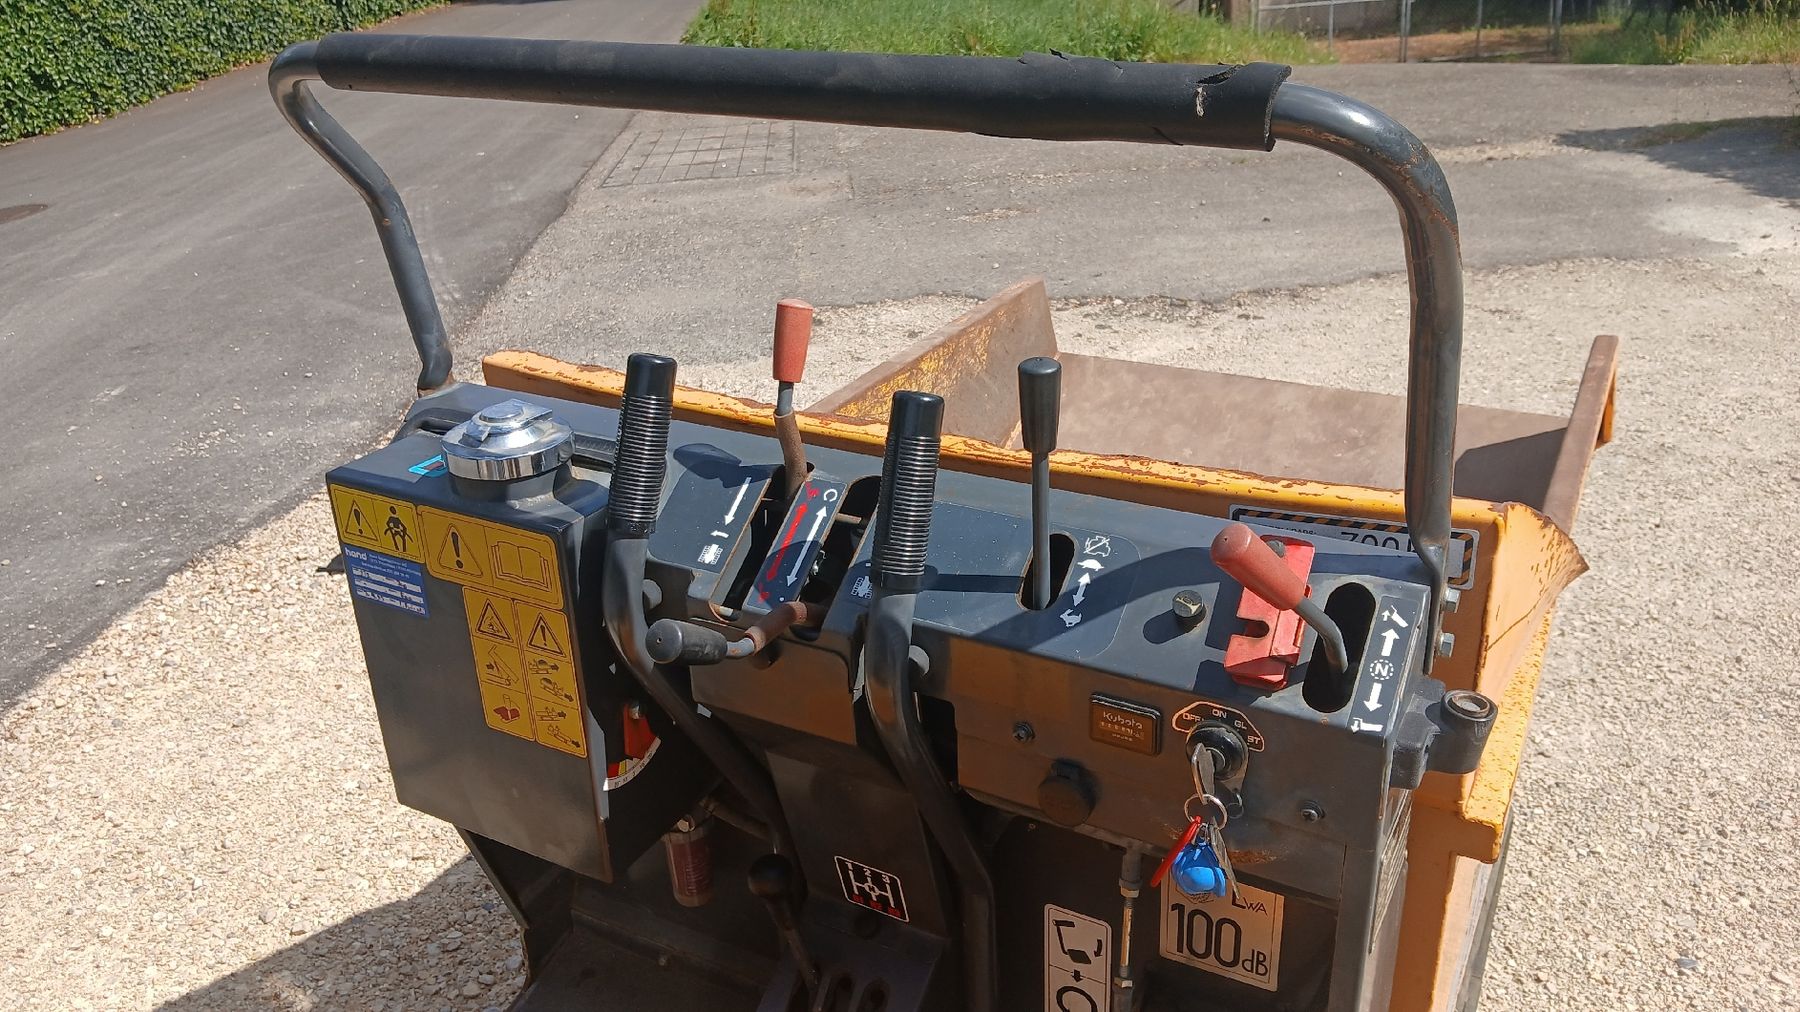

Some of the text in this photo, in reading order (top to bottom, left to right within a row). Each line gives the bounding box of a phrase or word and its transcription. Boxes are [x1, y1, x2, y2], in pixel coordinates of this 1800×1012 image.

[1374, 661, 1389, 678] N
[1103, 711, 1143, 730] Kubota
[1211, 708, 1227, 719] ON
[1234, 719, 1247, 730] GL
[1247, 735, 1261, 745] ST
[863, 868, 872, 877] 2
[881, 874, 891, 884] 3
[1170, 902, 1269, 976] 100 dB
